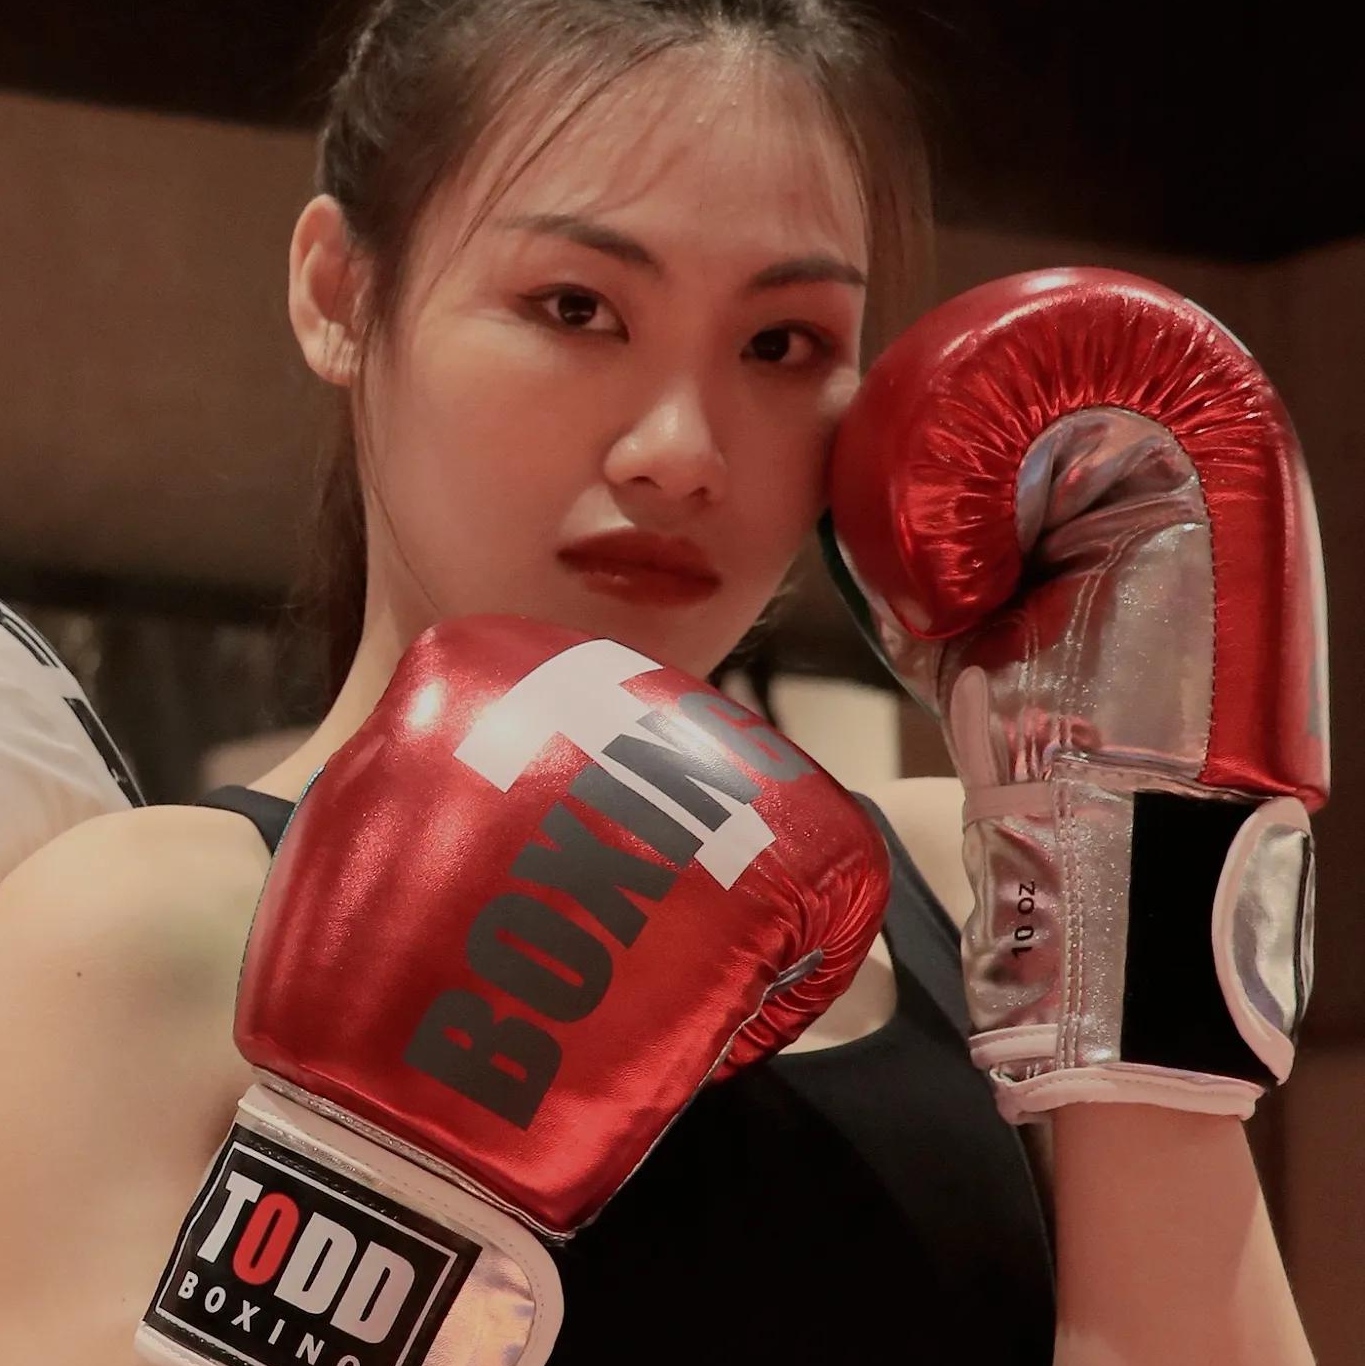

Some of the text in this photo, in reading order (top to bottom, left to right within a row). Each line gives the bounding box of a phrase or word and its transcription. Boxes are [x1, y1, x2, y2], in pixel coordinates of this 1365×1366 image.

[401, 691, 818, 1130] BOXING
[1011, 925, 1035, 959] 10
[196, 1170, 416, 1344] TODD
